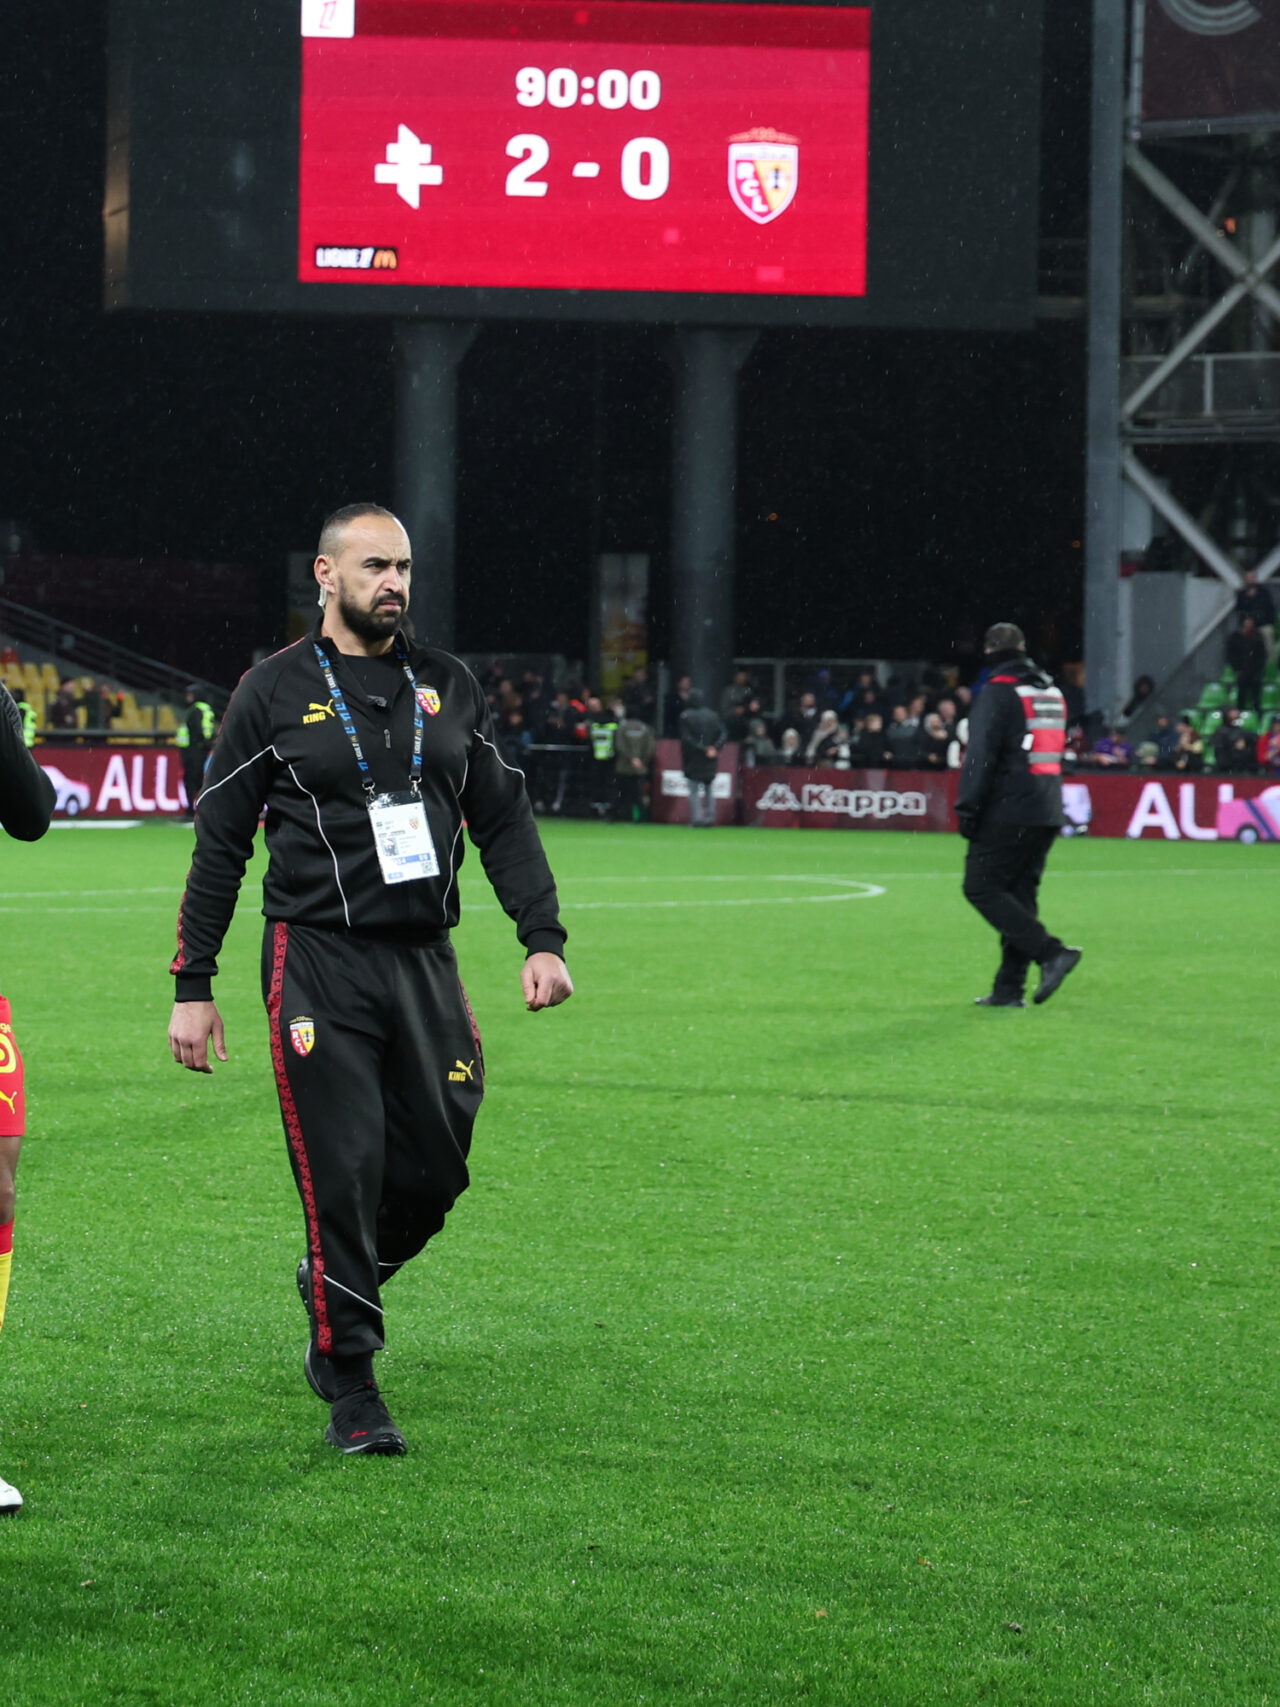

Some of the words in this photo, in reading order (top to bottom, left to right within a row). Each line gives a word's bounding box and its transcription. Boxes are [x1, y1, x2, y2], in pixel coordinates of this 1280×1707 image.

[515, 66, 662, 110] 90:00
[505, 133, 550, 198] 2
[621, 136, 670, 200] 0
[801, 783, 927, 819] Kappa
